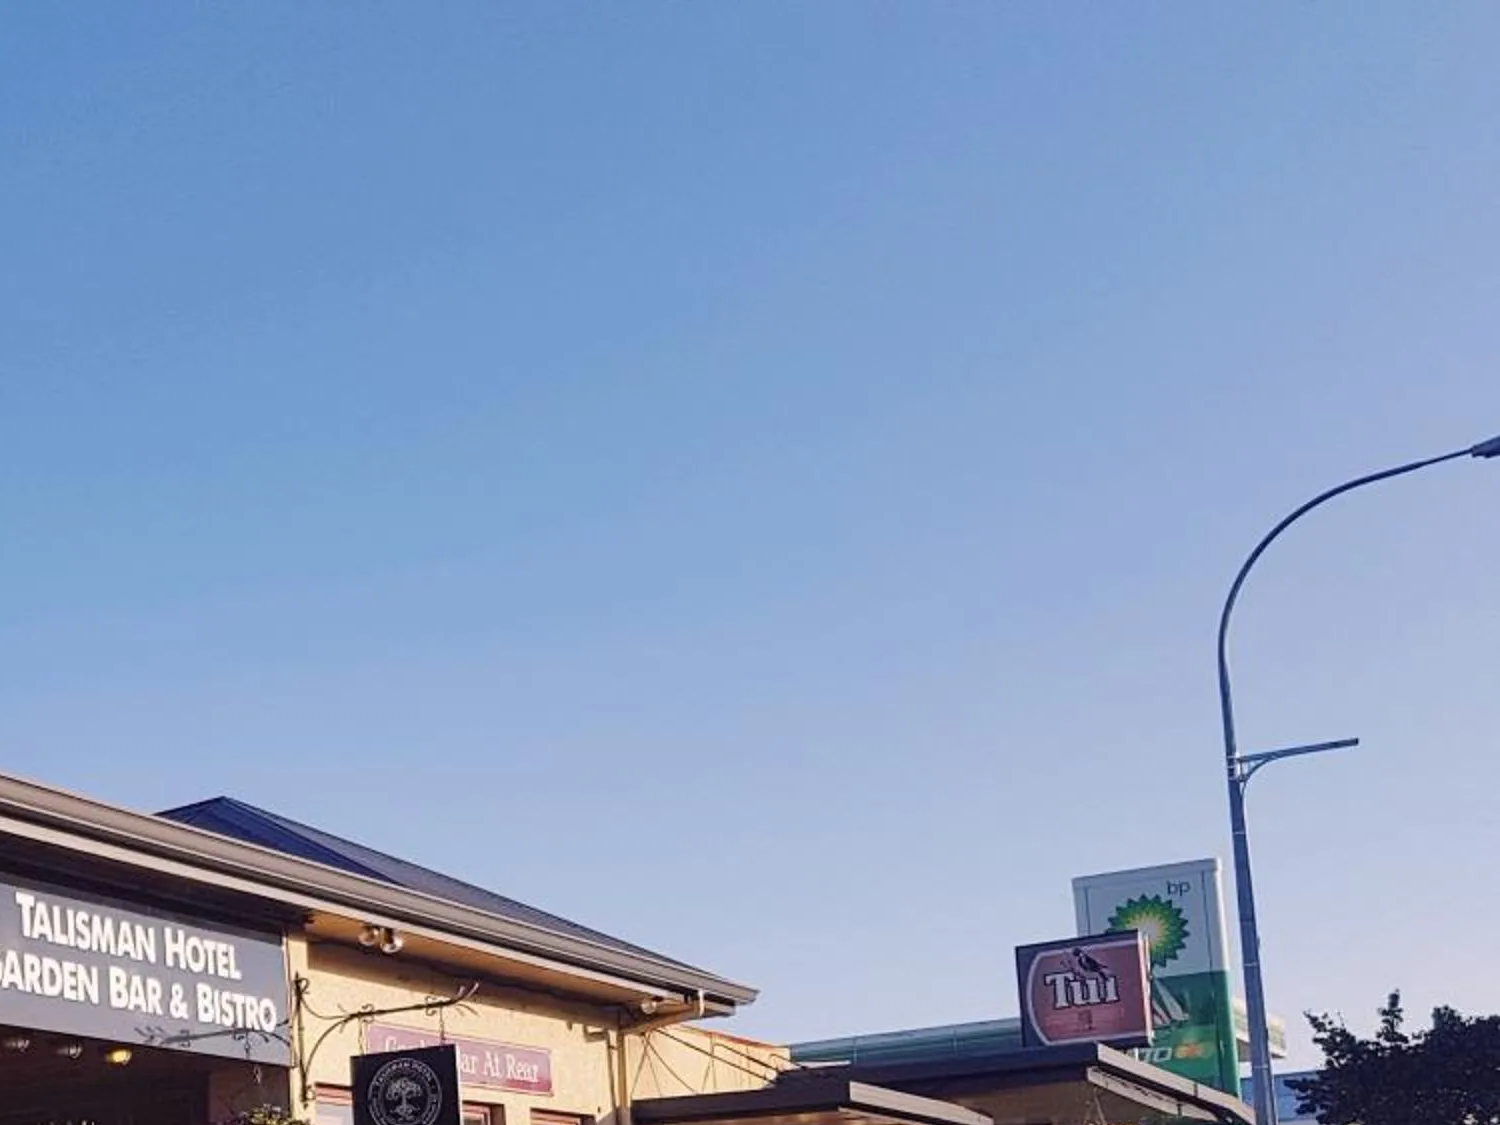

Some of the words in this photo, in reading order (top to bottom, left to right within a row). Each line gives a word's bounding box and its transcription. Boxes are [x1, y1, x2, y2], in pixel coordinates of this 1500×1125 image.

[1166, 880, 1191, 897] bp
[169, 983, 189, 1020] &
[1044, 970, 1119, 1009] Tui
[483, 1051, 501, 1078] At
[505, 1053, 540, 1083] Rear
